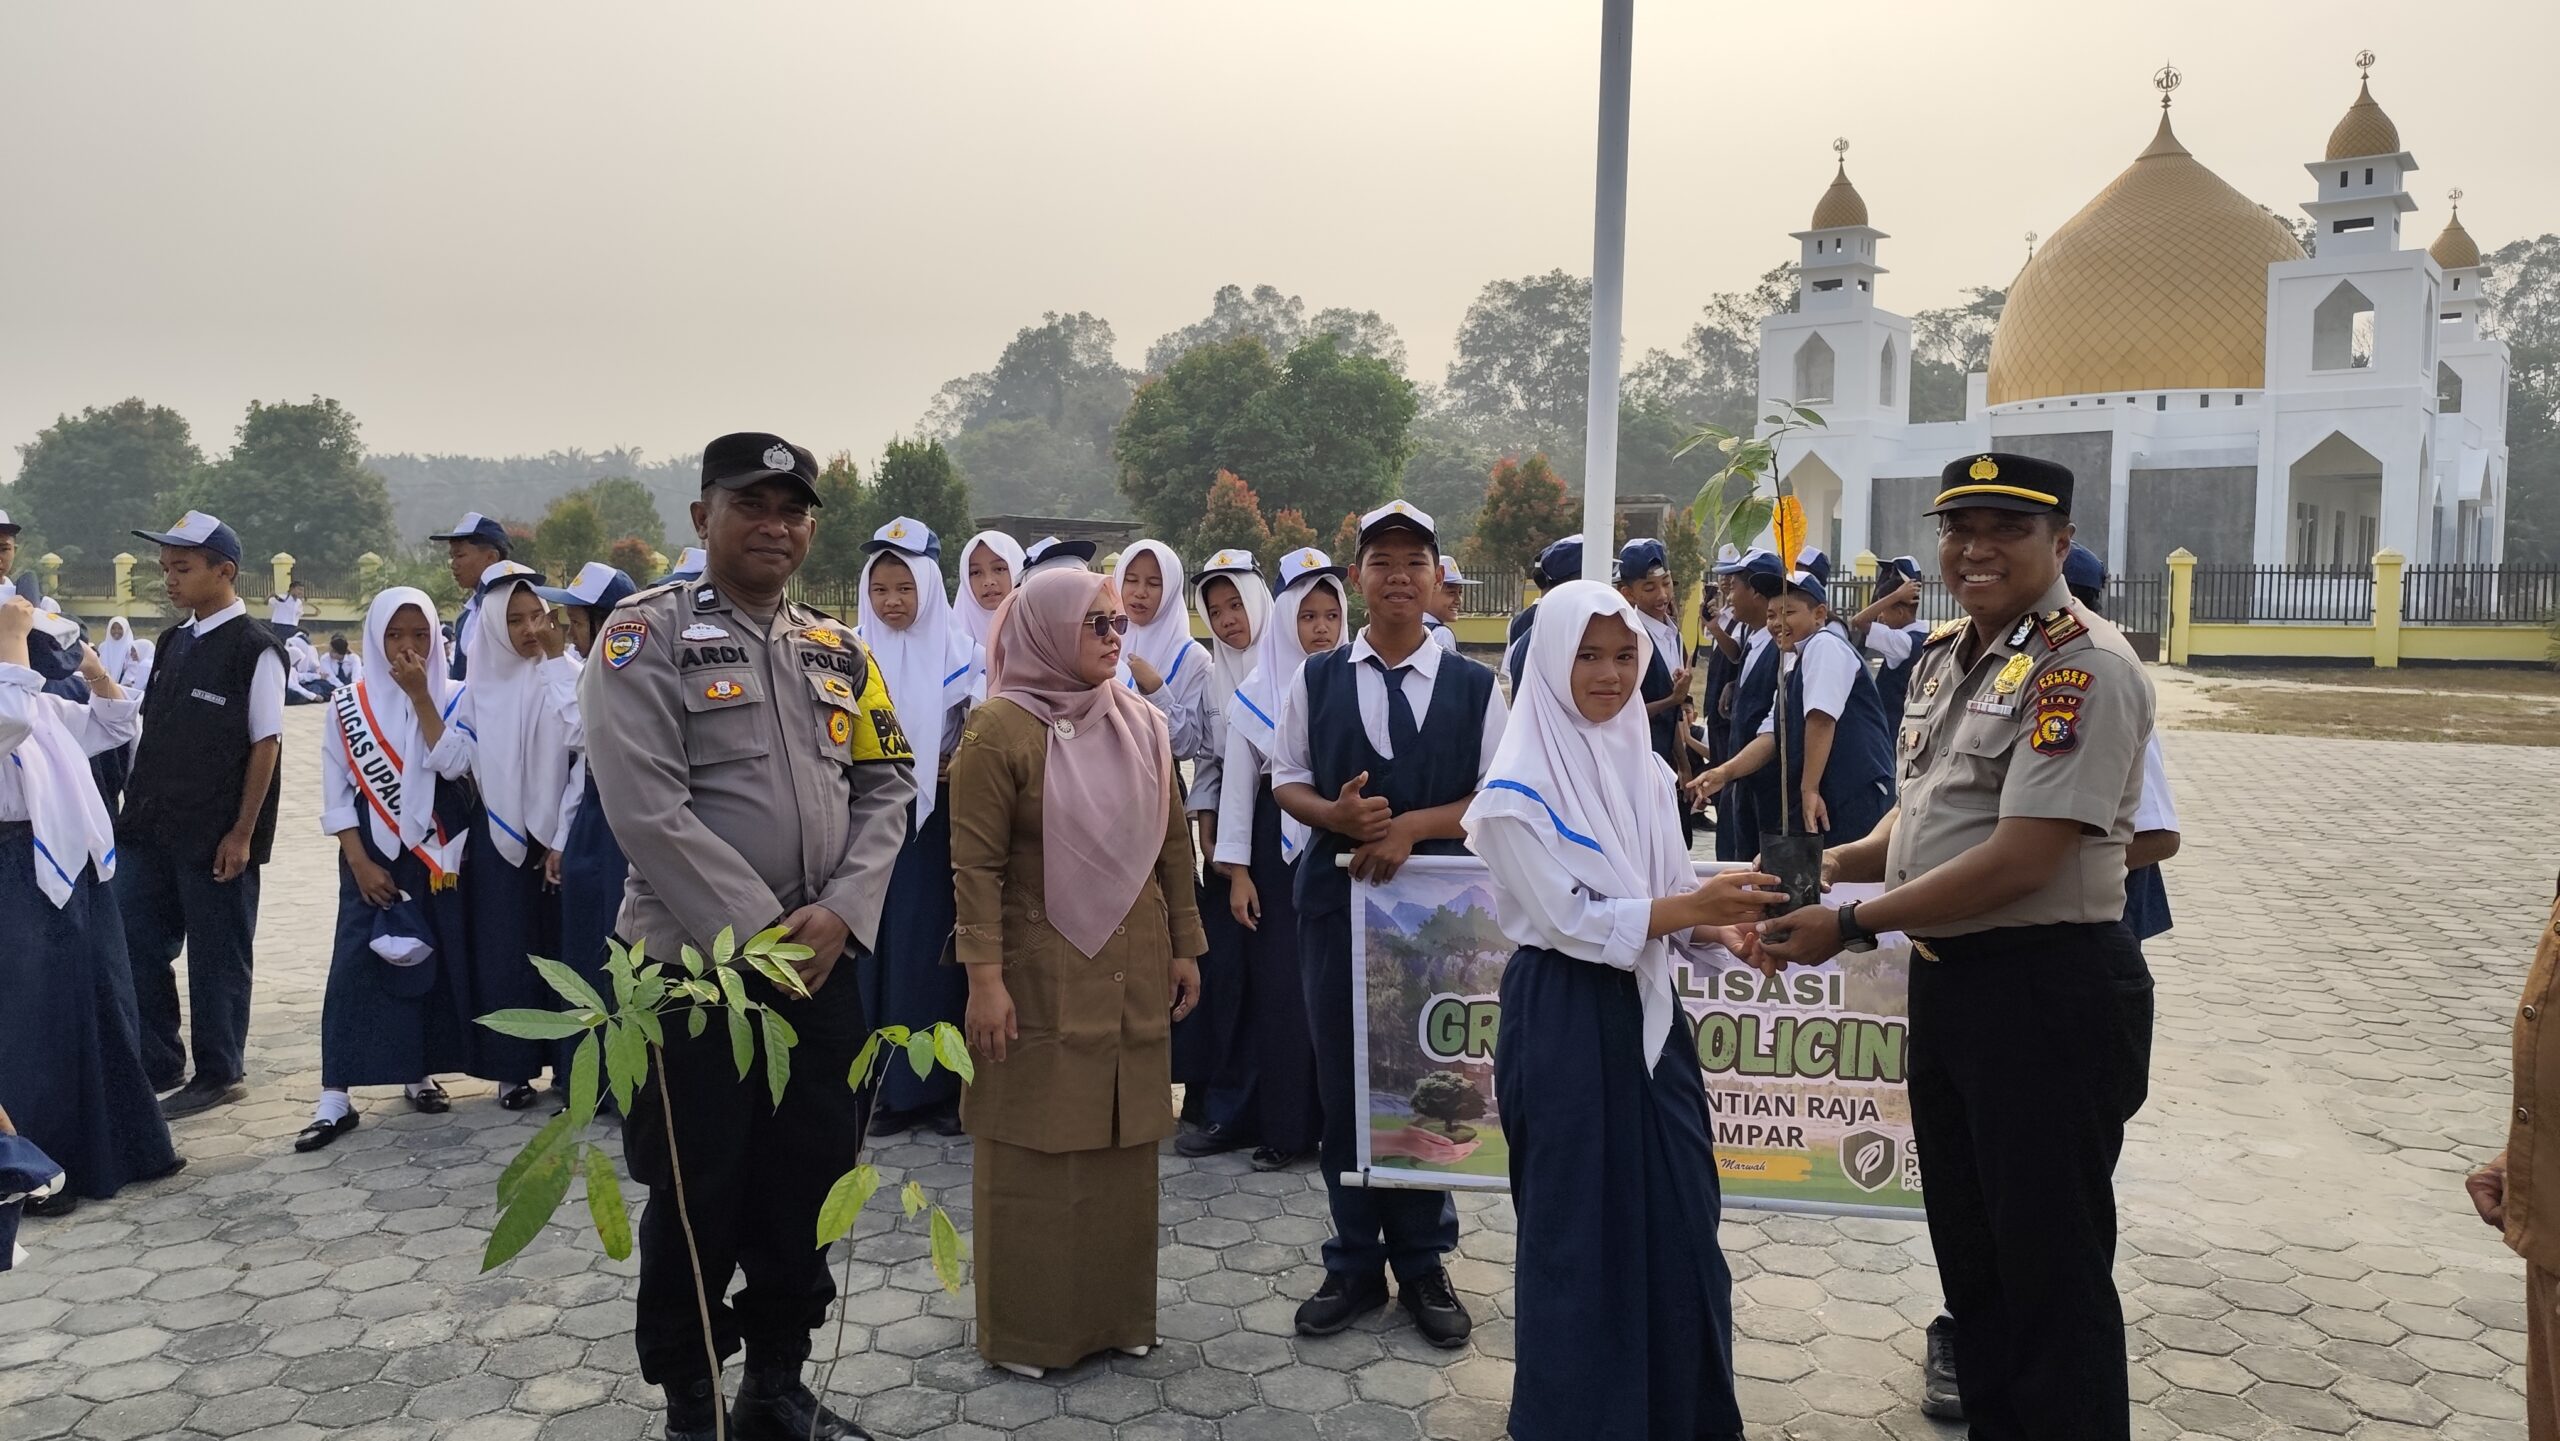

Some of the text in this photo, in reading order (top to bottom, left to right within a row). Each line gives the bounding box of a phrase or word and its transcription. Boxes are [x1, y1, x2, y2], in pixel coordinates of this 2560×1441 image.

[681, 646, 750, 668] ARDI
[2039, 669, 2088, 687] POLRES
[2041, 696, 2077, 705] RIAU
[1686, 1011, 1909, 1083] OLICIN
[1808, 1096, 1881, 1126] RAJA
[1720, 1158, 1766, 1171] Marwah
